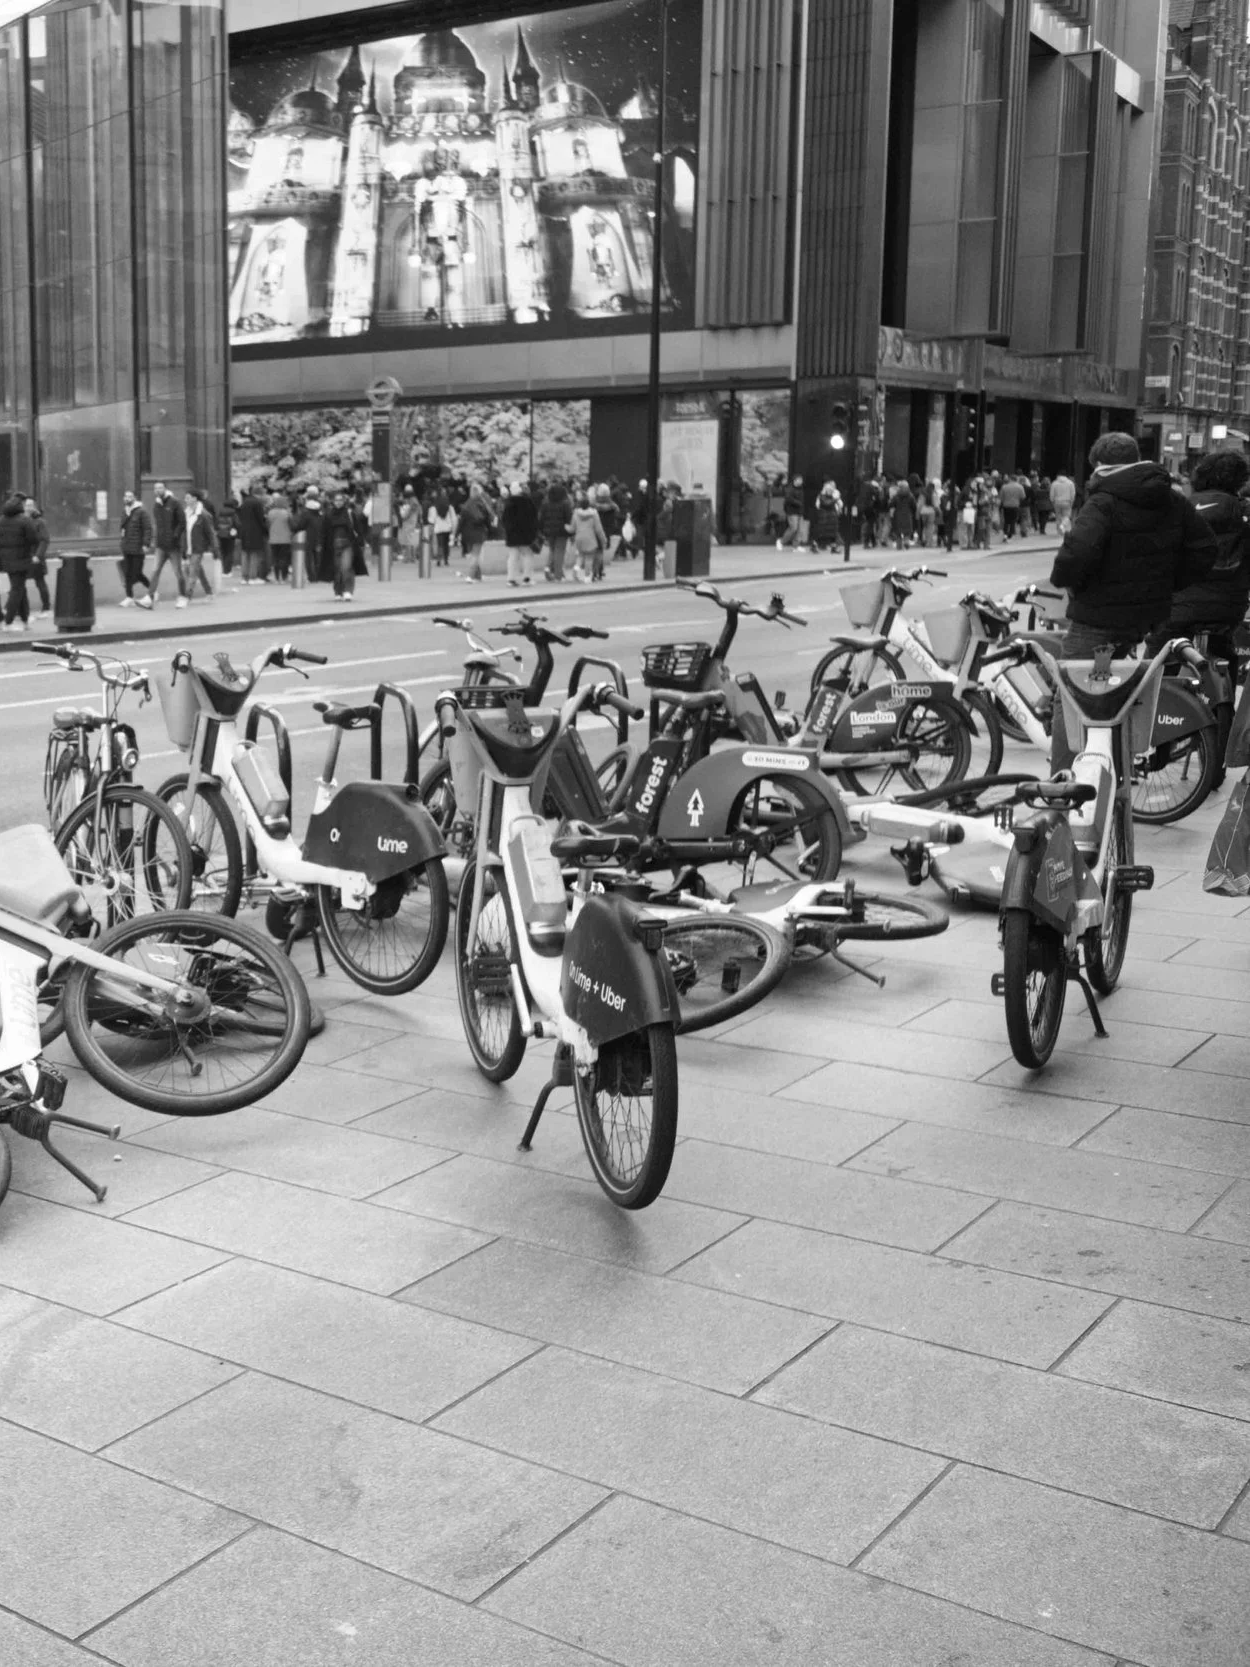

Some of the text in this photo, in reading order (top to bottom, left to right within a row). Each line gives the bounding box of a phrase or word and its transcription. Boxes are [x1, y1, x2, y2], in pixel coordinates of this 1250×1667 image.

[892, 685, 931, 697] home
[812, 692, 837, 732] forest
[851, 710, 897, 724] London
[1158, 714, 1184, 726] Uber
[635, 756, 668, 814] forest
[377, 836, 409, 853] Lime
[574, 966, 592, 992] Lime
[593, 981, 599, 994] +
[600, 983, 627, 1012] Uber
